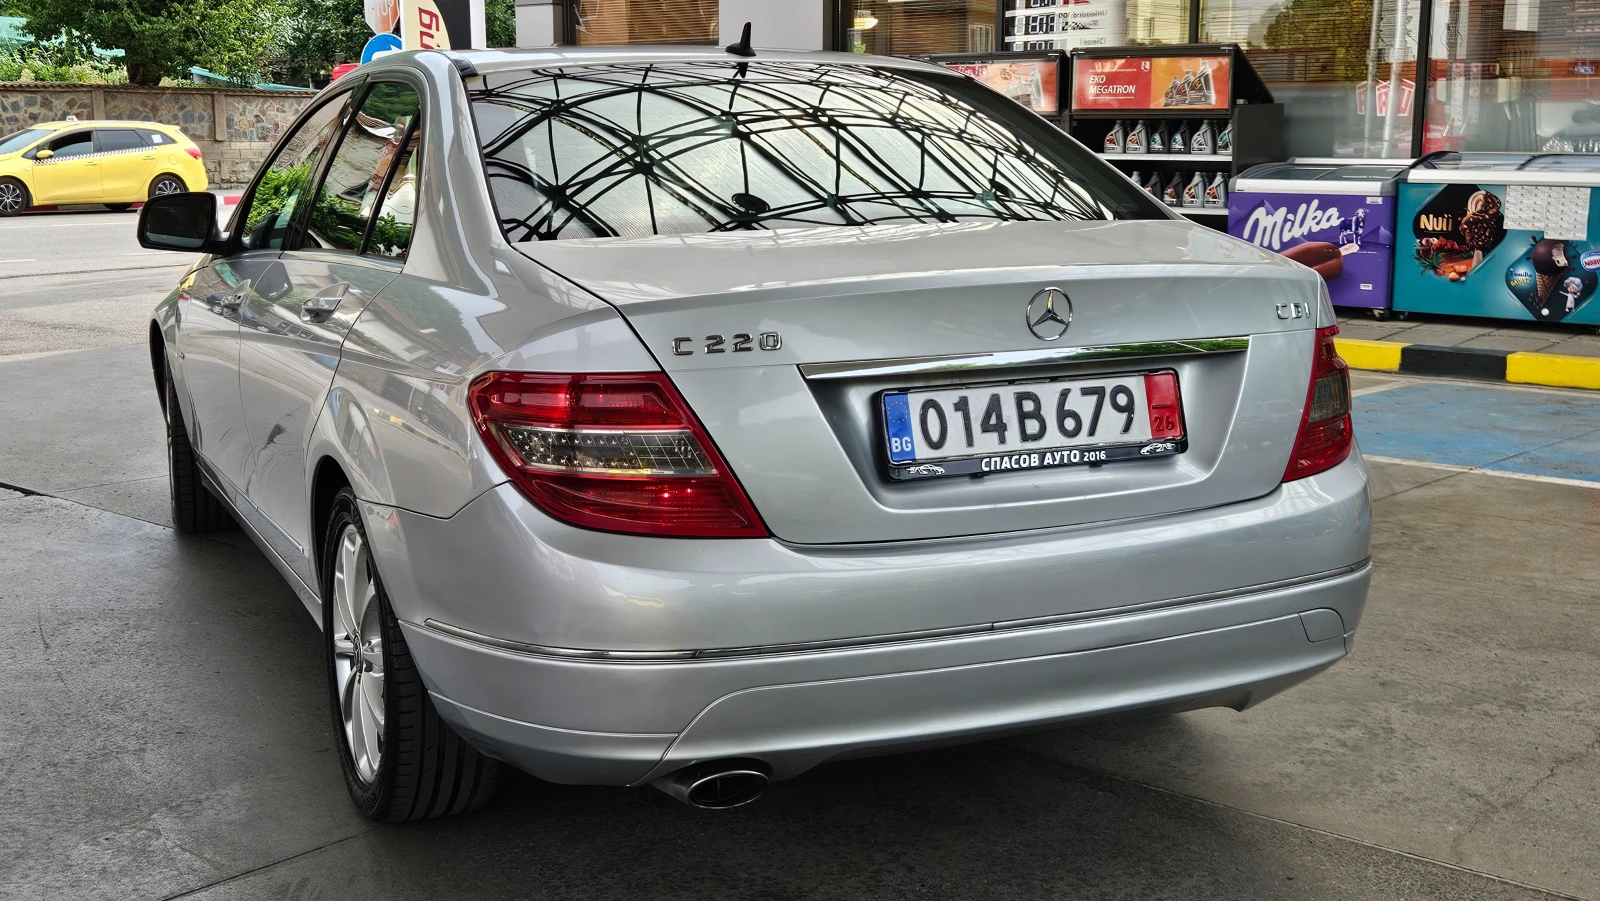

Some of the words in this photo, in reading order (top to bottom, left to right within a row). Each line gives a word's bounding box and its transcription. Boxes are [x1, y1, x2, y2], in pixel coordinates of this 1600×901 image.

[1089, 75, 1106, 84] EKO
[1089, 85, 1136, 94] MEGATRON
[1243, 199, 1345, 250] Milka
[672, 337, 694, 356] C
[704, 332, 783, 354] 220
[1153, 415, 1176, 432] 26
[891, 436, 912, 453] BG
[981, 453, 1039, 472] СПАСОВ
[1043, 450, 1080, 466] АУТО
[1083, 450, 1107, 462] 2016
